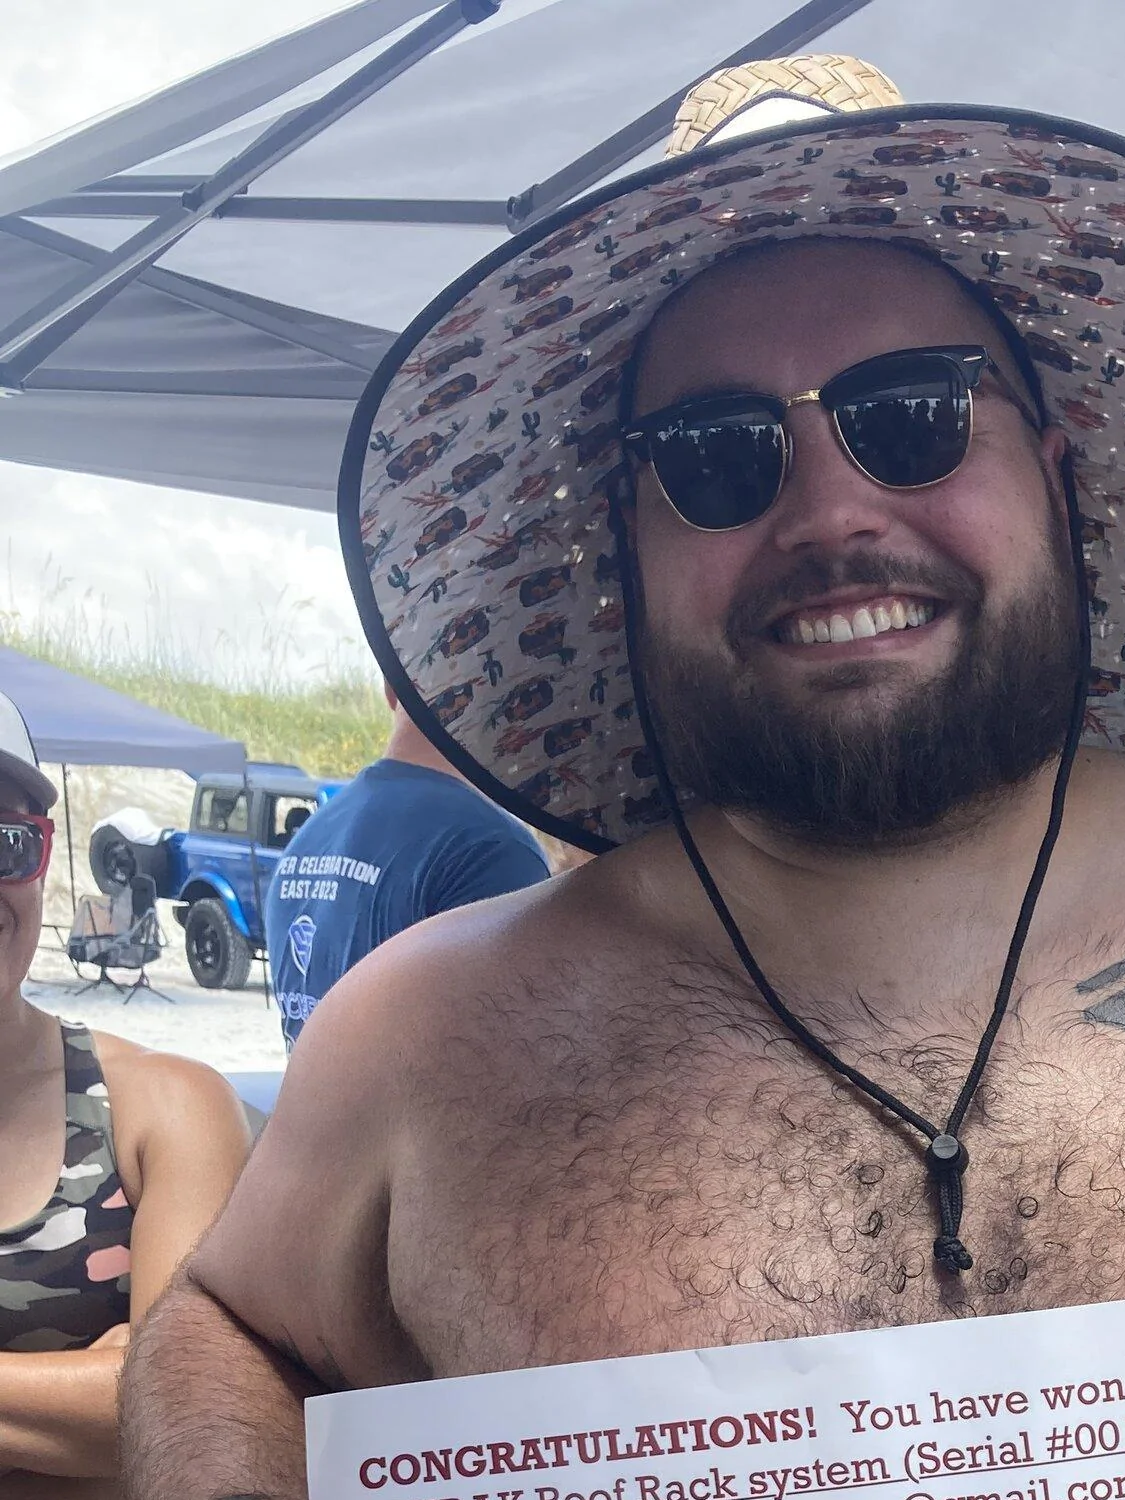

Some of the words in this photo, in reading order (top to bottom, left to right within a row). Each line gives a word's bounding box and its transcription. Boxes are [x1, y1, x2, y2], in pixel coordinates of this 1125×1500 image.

[280, 880, 311, 900] EAST
[311, 880, 339, 901] 2023
[299, 856, 381, 886] CELEBRATION
[359, 1406, 817, 1489] CONGRATULATIONS!
[840, 1399, 921, 1433] You
[930, 1390, 1029, 1423] have
[749, 1455, 891, 1500] system
[904, 1431, 1035, 1483] (Serial
